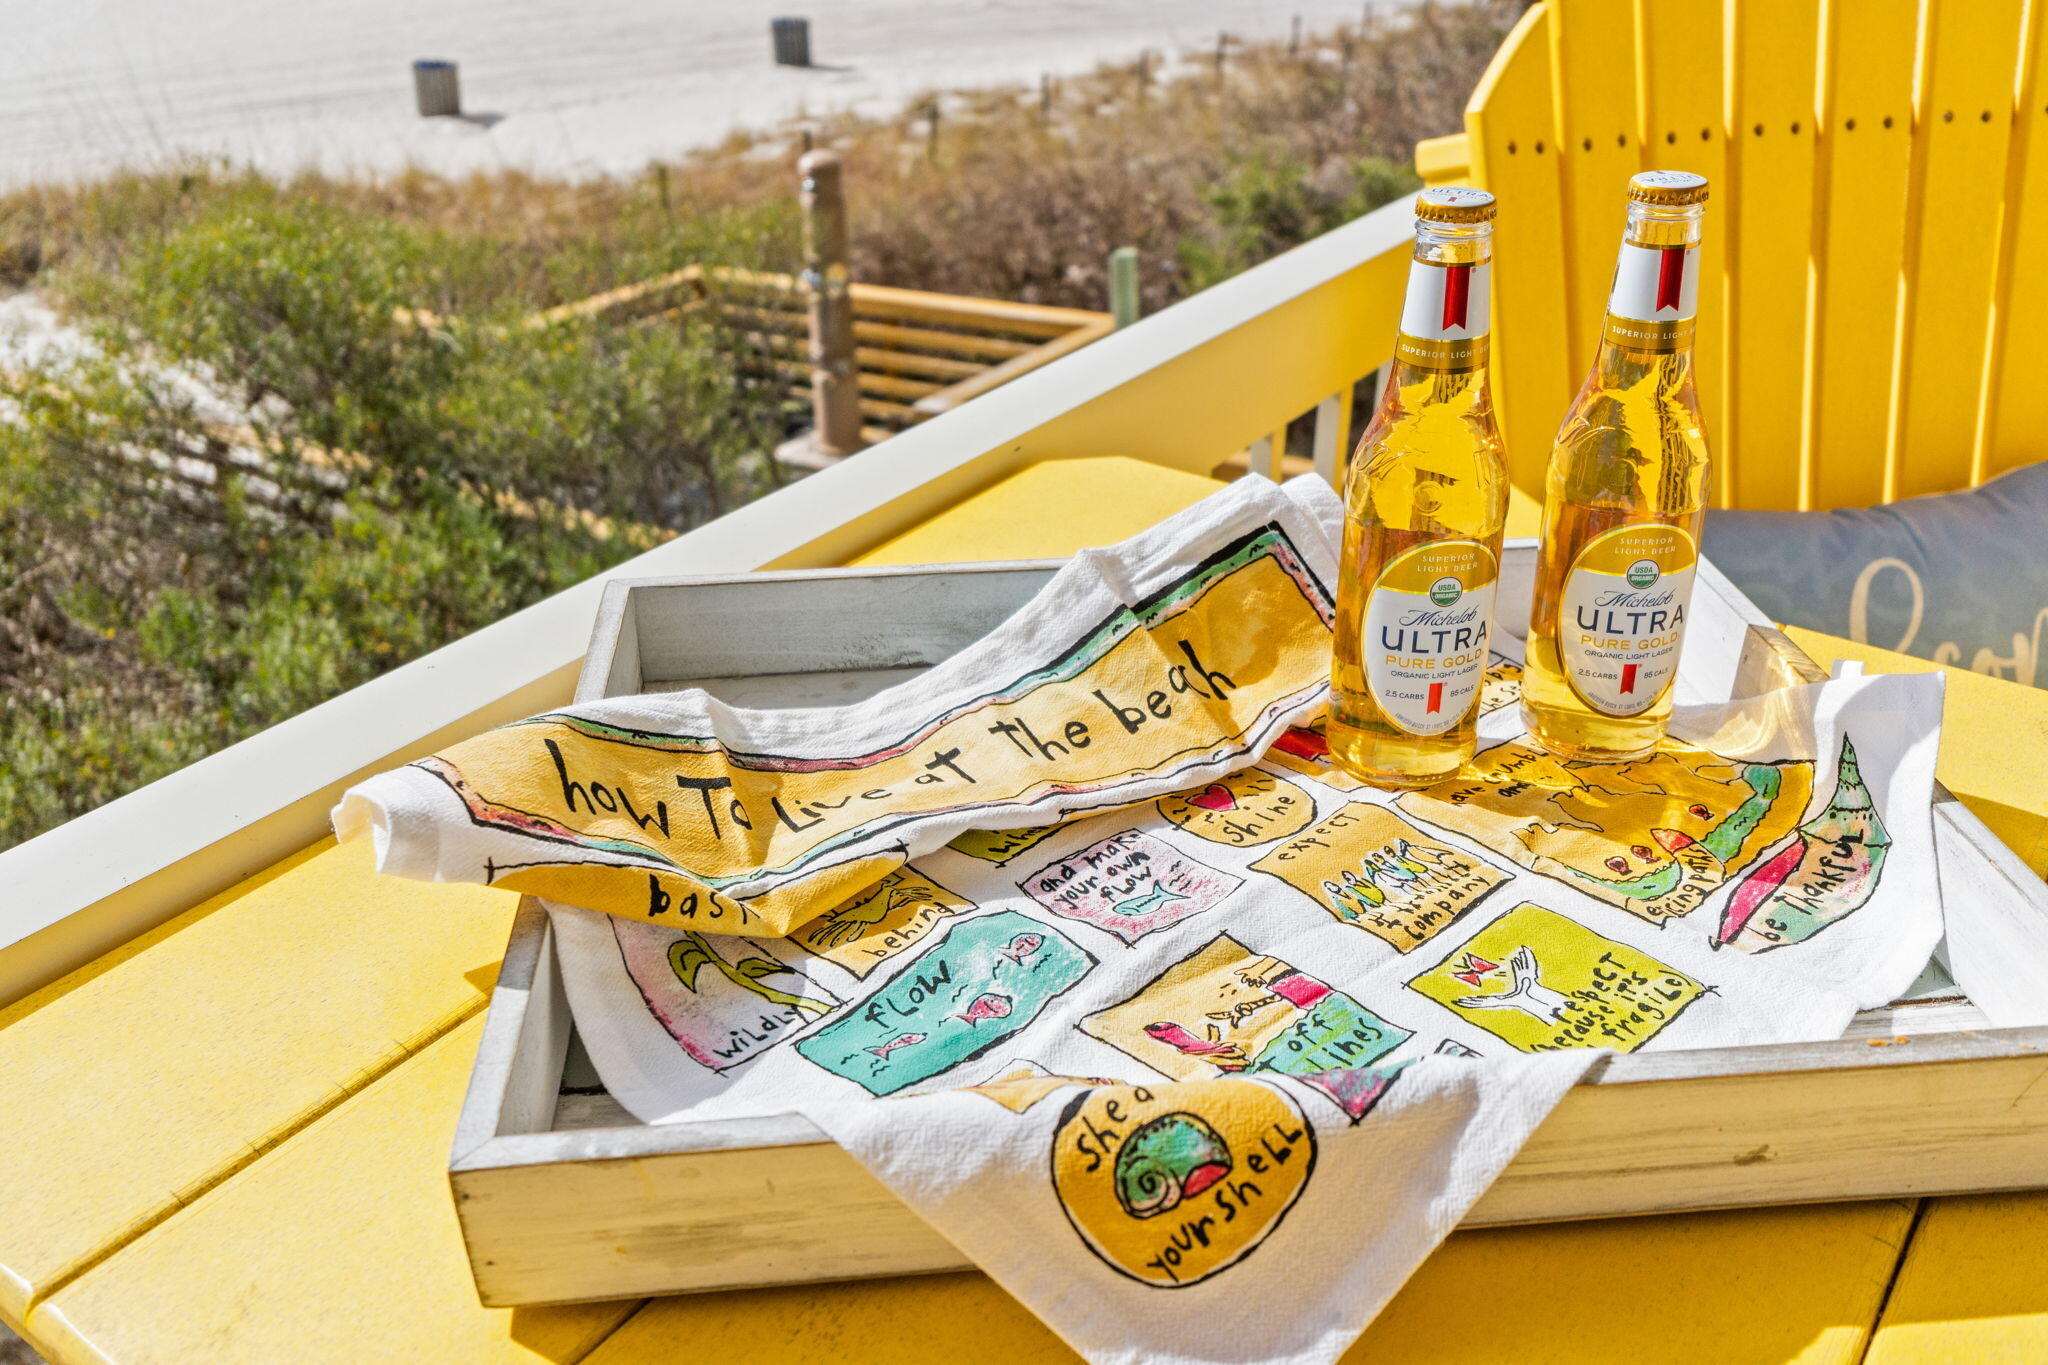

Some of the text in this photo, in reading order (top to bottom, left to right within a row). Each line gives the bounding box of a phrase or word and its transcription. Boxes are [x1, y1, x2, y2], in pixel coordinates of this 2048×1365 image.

[1612, 325, 1658, 340] SUPERIOR
[1401, 343, 1446, 359] SUPERIOR
[1450, 349, 1477, 360] LIGHT
[1620, 536, 1673, 546] SUPERIOR
[1422, 552, 1475, 564] SUPERIOR
[1614, 545, 1676, 556] LIGHT BEER
[1417, 561, 1479, 573] LIGHT BEER
[1634, 565, 1654, 574] USDA
[1437, 583, 1457, 592] USDA
[1594, 586, 1678, 609] Michelob
[1398, 602, 1480, 627] Michelob
[1577, 603, 1685, 635] ULTRA
[1381, 620, 1487, 654] ULTRA
[1580, 631, 1679, 651] PURE GOLD
[1385, 647, 1483, 670] PURE GOLD
[1584, 646, 1674, 660] ORGANIC LIGHT LAGER
[1390, 670, 1430, 680] ORGANIC
[1431, 670, 1456, 679] LIGHT
[1457, 663, 1479, 676] LAGER
[1578, 668, 1618, 680] 2.5 CARBS
[1643, 667, 1669, 679] 85 CALS
[1385, 689, 1425, 700] 2.5 CARBS
[1450, 684, 1475, 698] 85 CALS
[544, 738, 671, 839] how
[1222, 796, 1296, 843] shine
[1040, 863, 1077, 893] and
[1053, 851, 1151, 910] your own
[861, 901, 956, 958] behind
[1746, 918, 1788, 942] be
[1287, 1013, 1334, 1052] off
[1146, 1216, 1215, 1283] your
